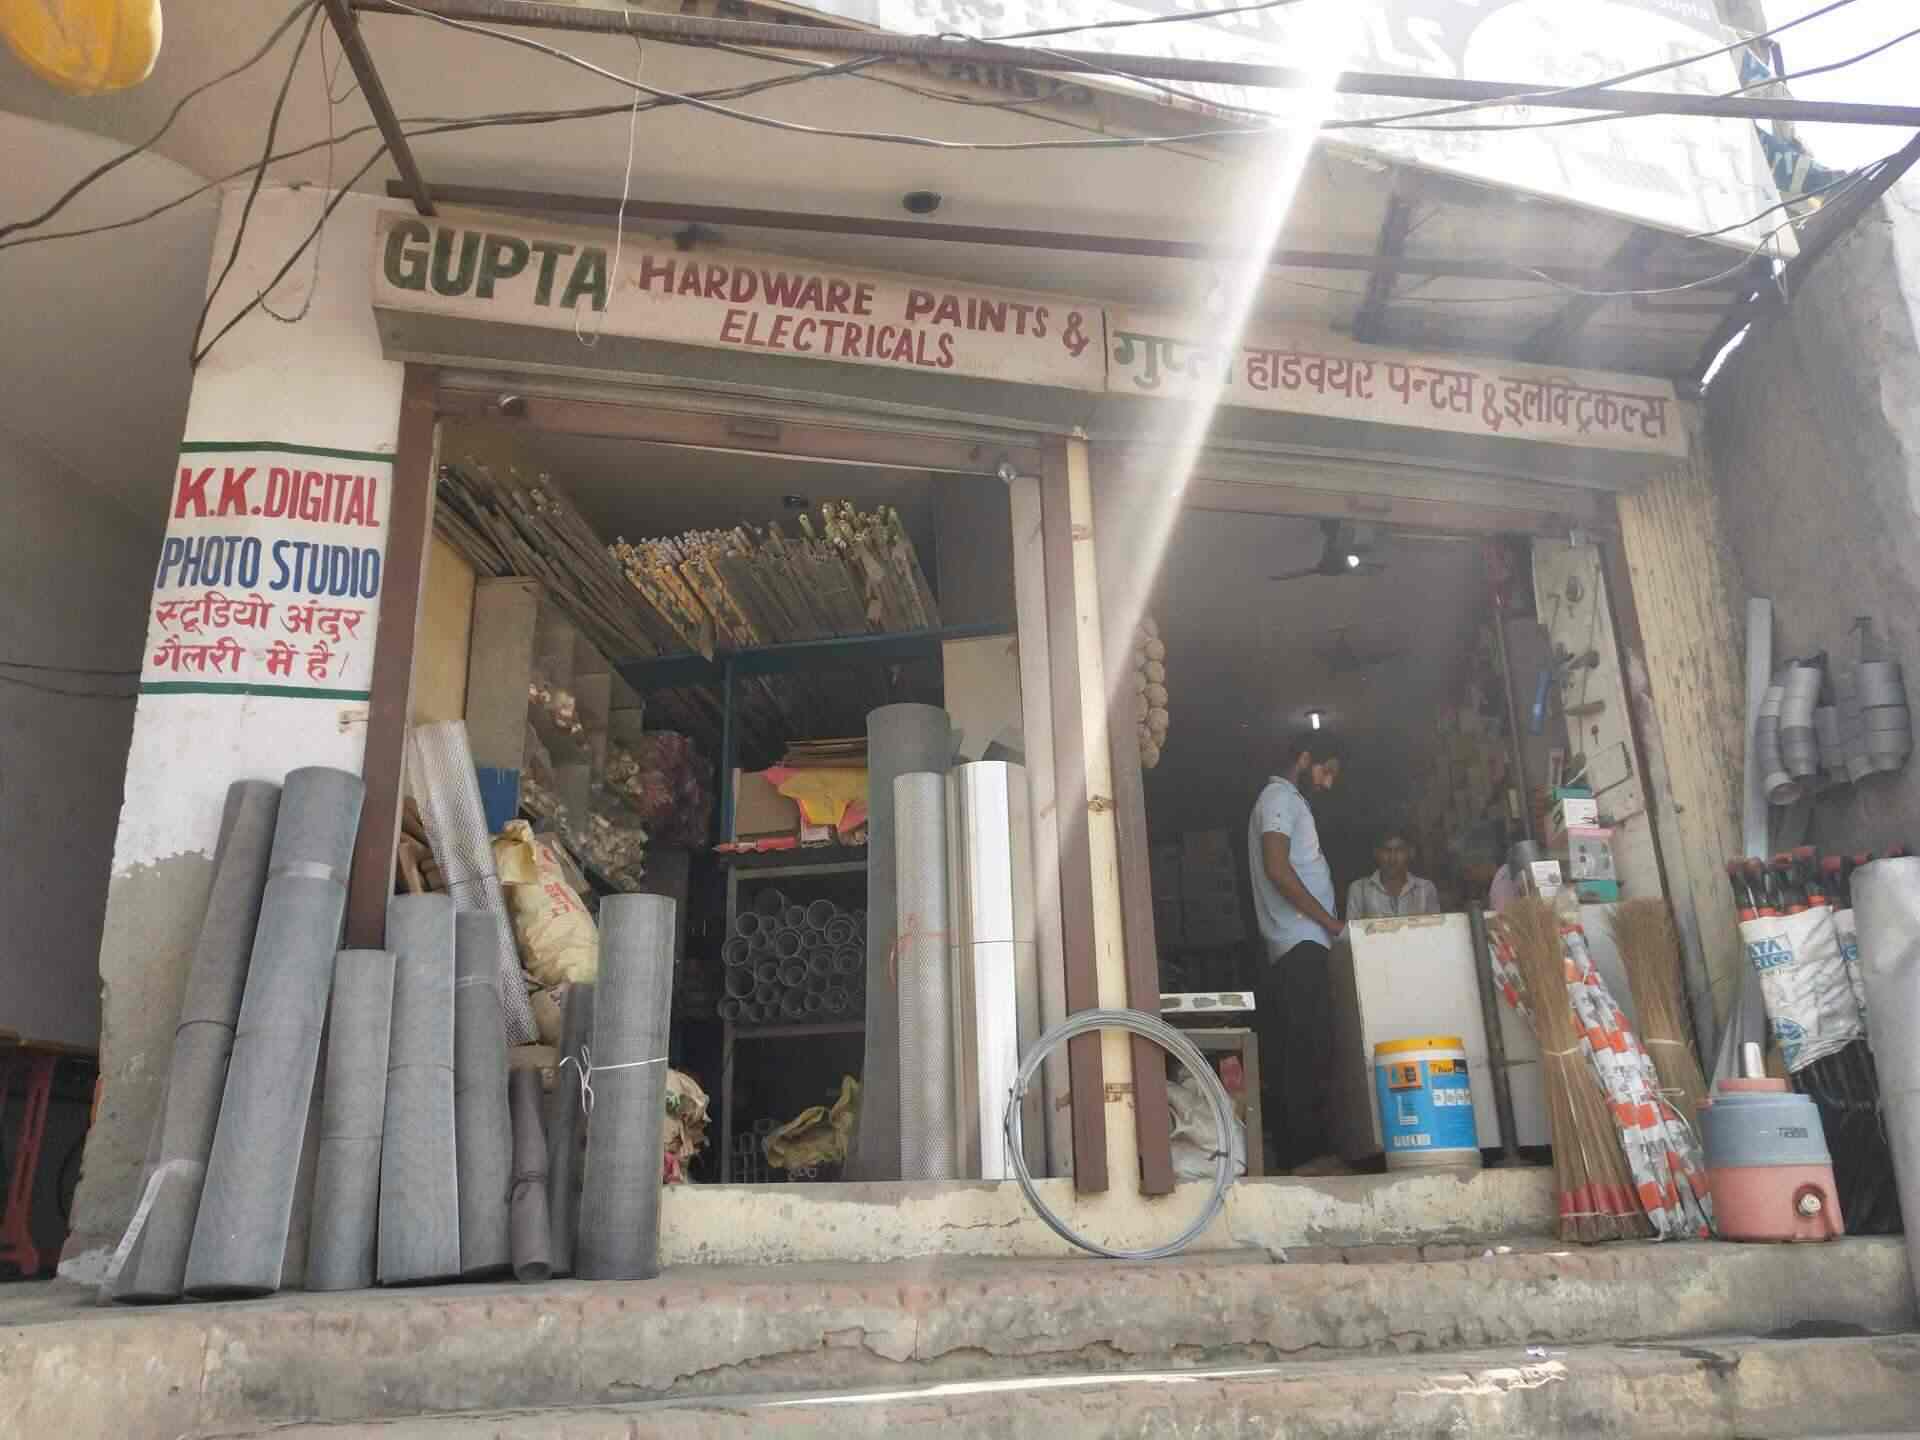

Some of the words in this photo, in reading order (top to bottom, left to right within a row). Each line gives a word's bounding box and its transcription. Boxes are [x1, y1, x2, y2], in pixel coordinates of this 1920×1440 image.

[384, 218, 608, 312] GUPTA
[639, 255, 875, 316] HARDWARE
[904, 288, 1050, 338] PAINTS
[1062, 311, 1090, 358] &
[719, 308, 956, 369] ELECTRICALS
[156, 535, 263, 589] PHOTO
[269, 539, 381, 599] STUDIO
[264, 639, 300, 678] में
